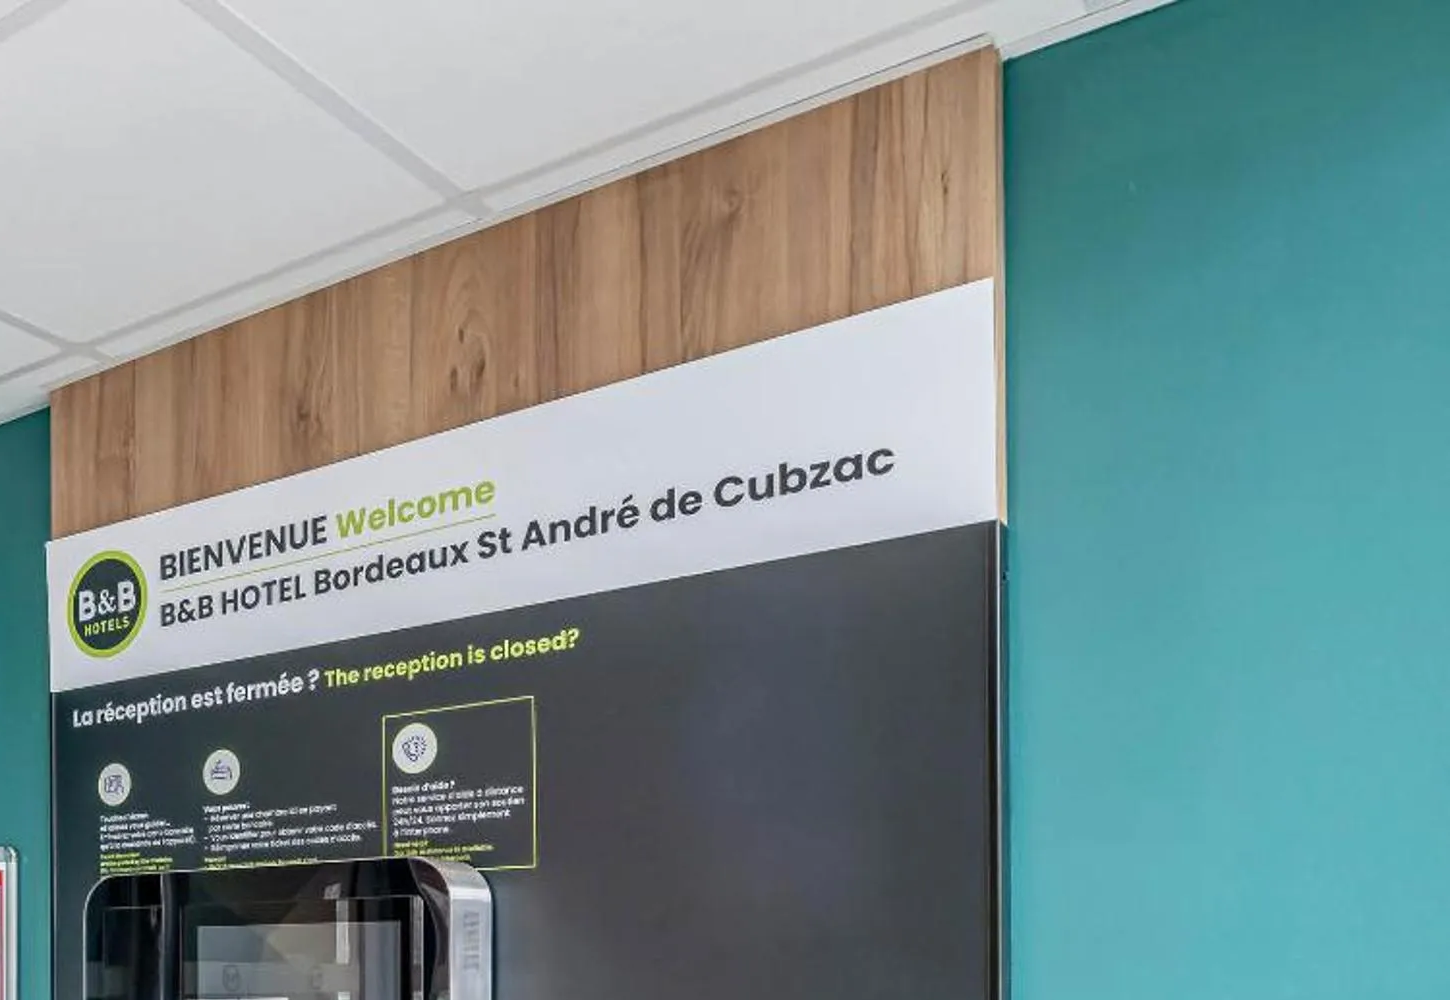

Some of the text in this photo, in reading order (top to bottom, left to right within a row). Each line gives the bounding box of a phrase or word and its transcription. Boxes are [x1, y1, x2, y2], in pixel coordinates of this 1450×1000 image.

[160, 480, 496, 580] BIENVENUE Welcome
[160, 448, 894, 627] B&B HOTEL Bordeaux St André de Cubzac
[78, 581, 136, 622] B&B
[84, 616, 130, 637] HOTELS
[73, 628, 579, 728] La réception est fermée ? The reception is closed?
